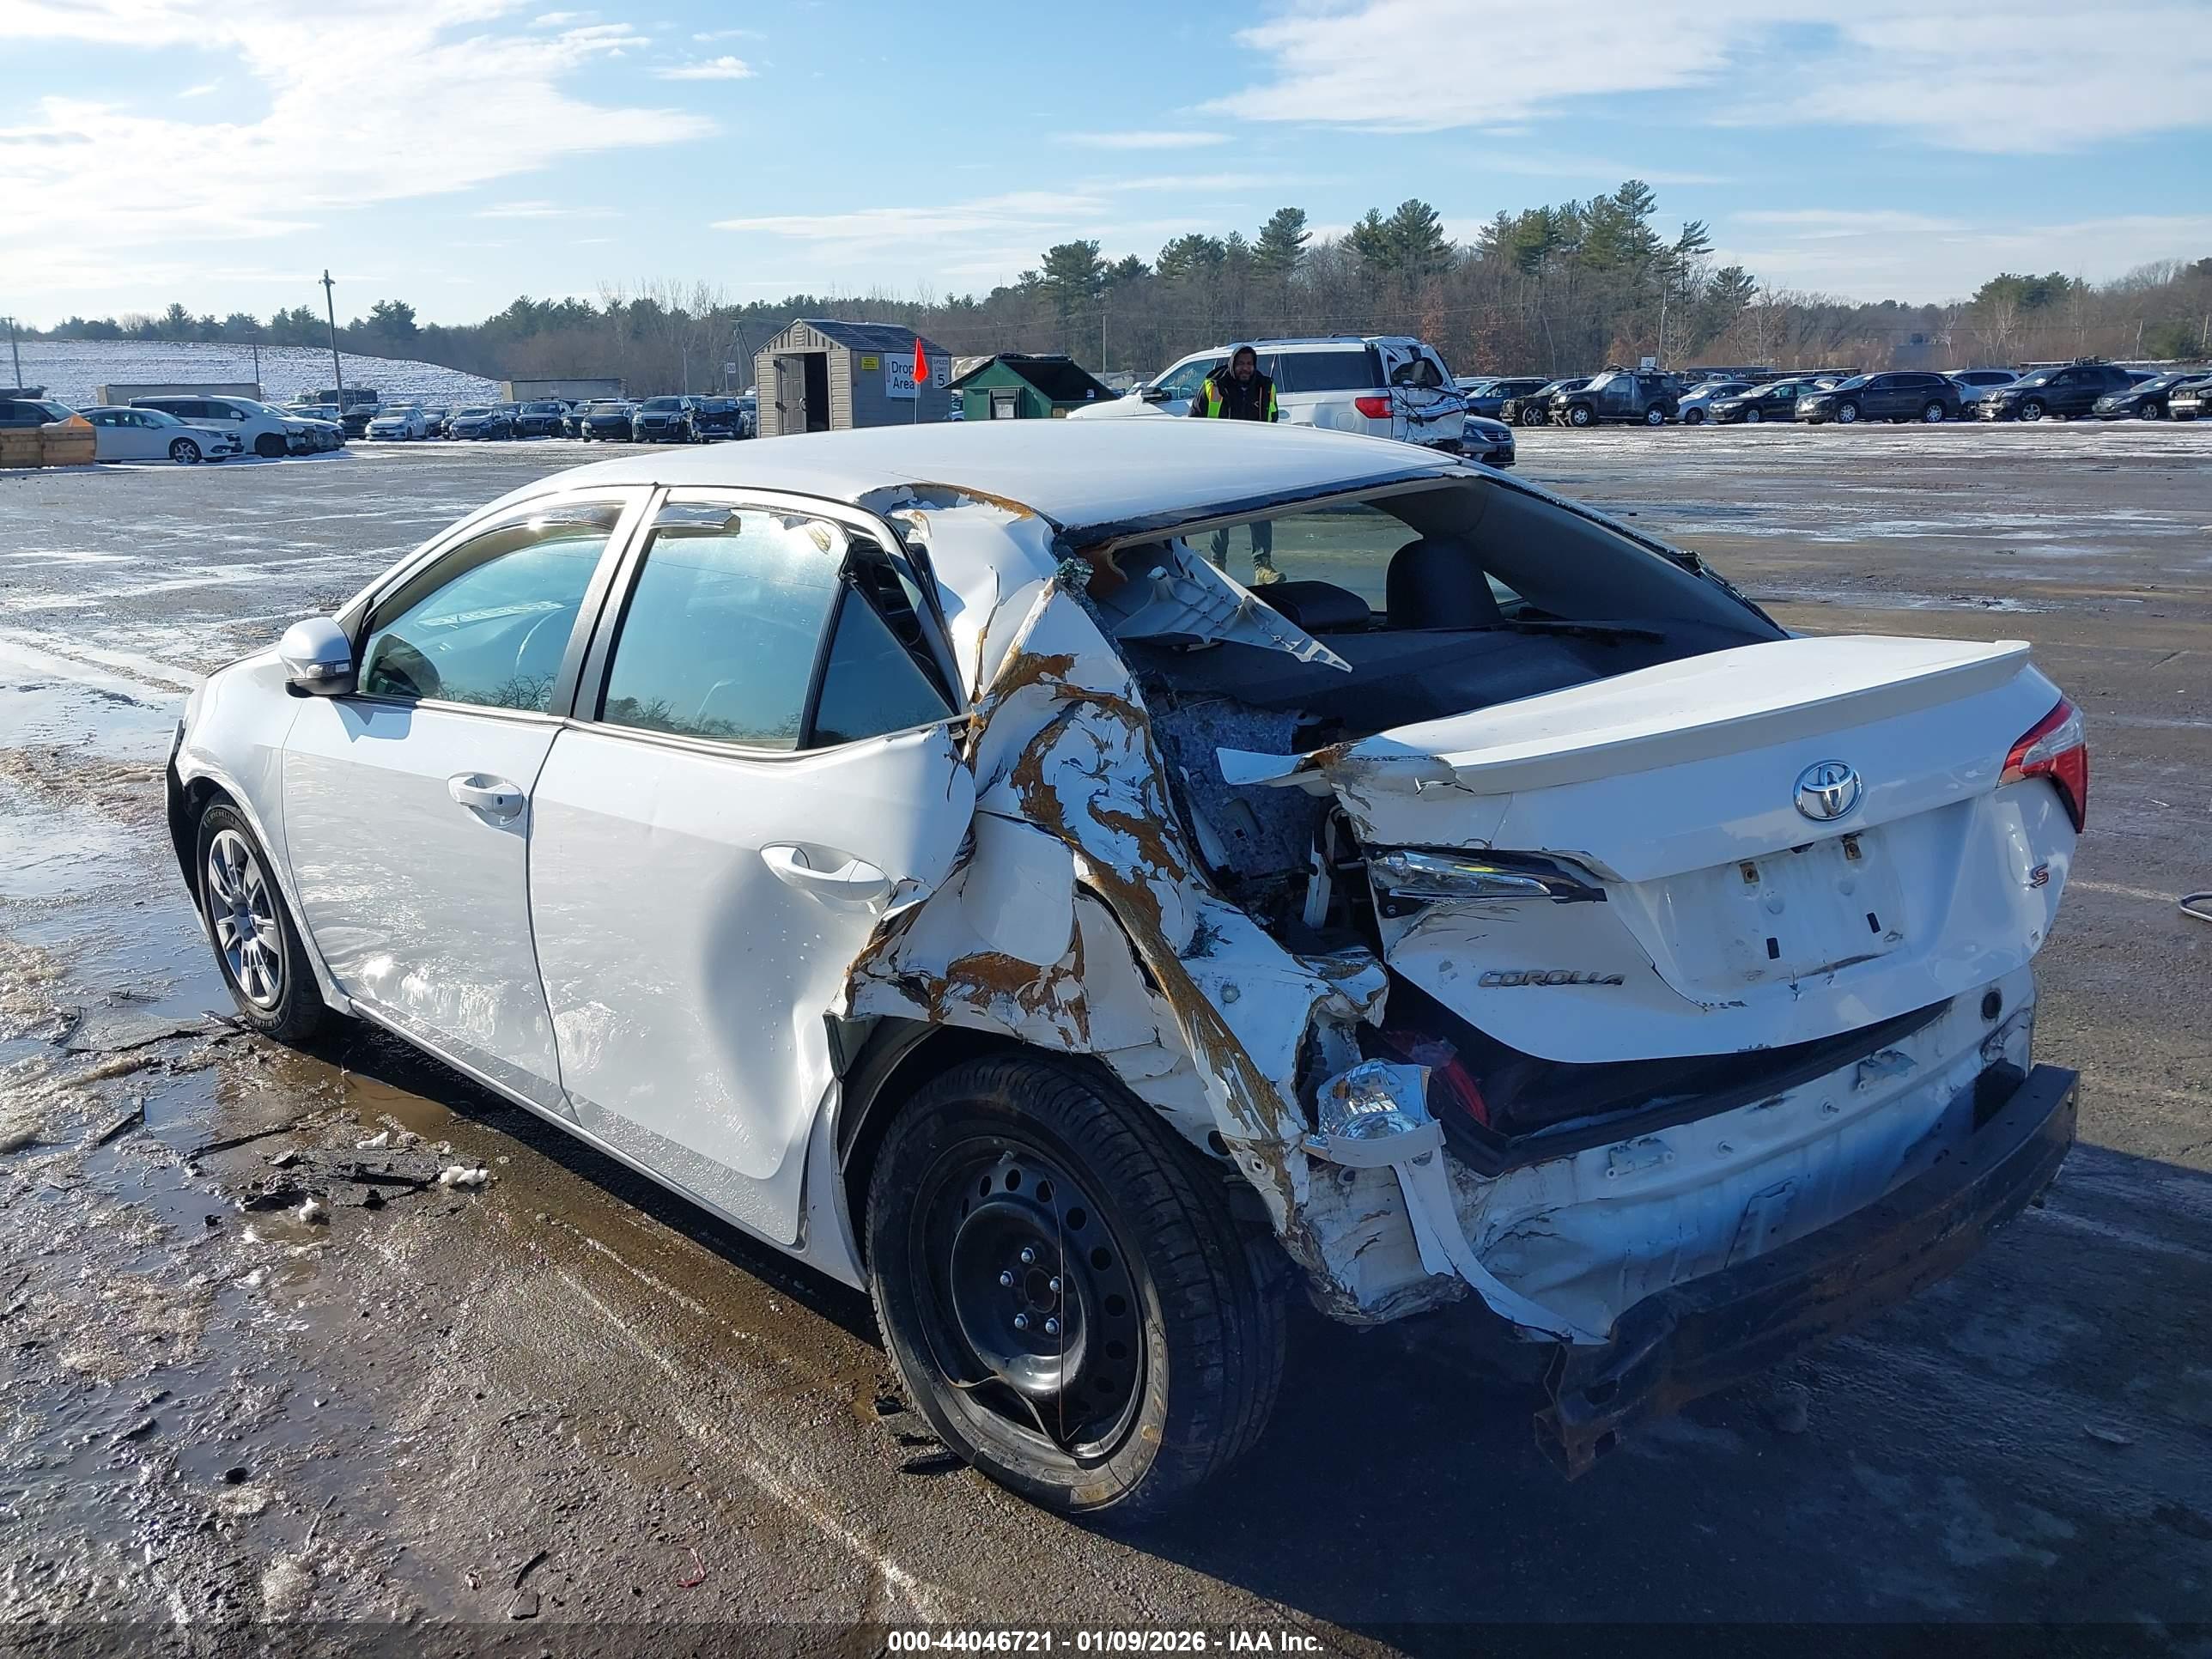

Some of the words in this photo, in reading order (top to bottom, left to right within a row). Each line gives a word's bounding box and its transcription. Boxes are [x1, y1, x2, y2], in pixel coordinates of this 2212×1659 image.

[891, 361, 915, 377] Drop
[893, 376, 915, 390] Area
[938, 374, 945, 386] 5
[2029, 863, 2050, 889] S
[1478, 969, 1626, 988] COROLLA
